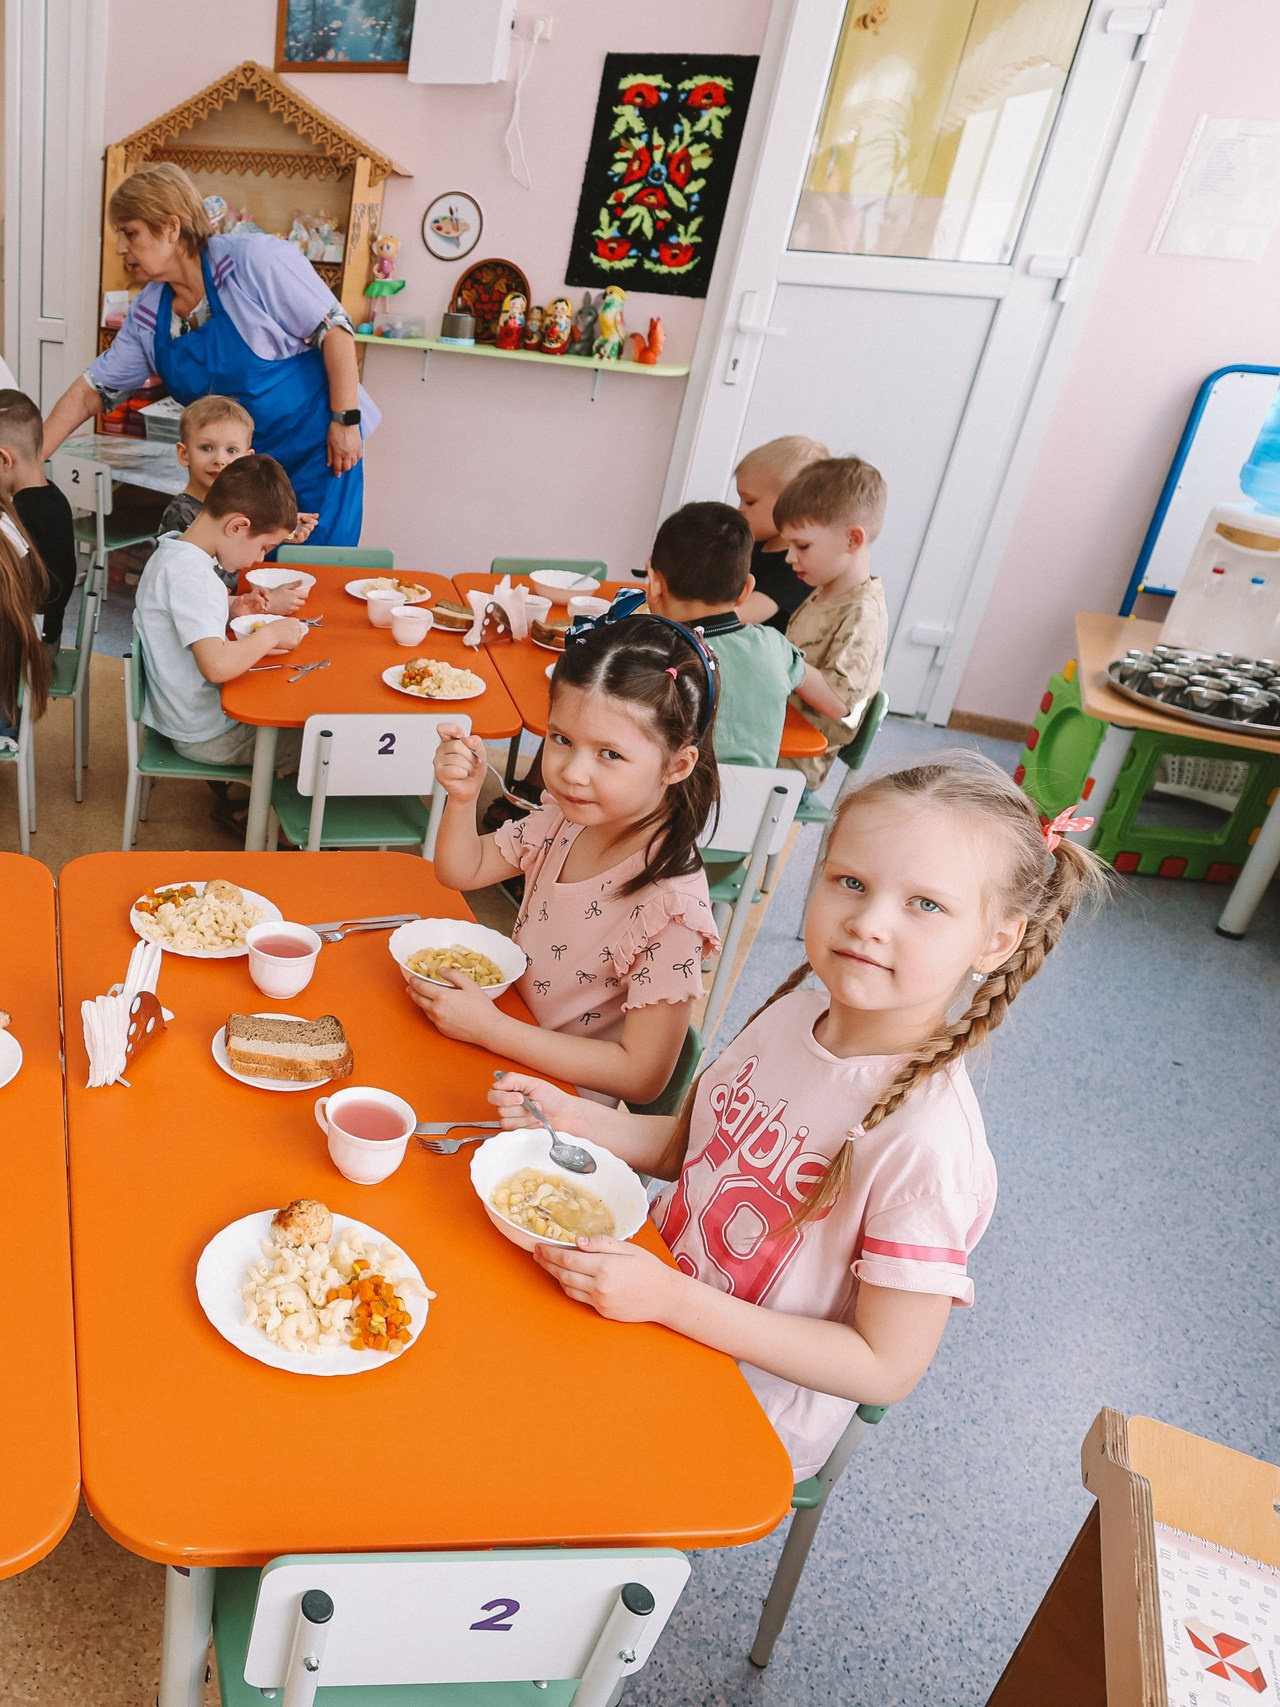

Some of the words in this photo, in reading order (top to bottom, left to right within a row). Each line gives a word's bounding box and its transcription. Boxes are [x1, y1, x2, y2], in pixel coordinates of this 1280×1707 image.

[71, 469, 80, 485] 2
[378, 733, 396, 755] 2
[468, 1598, 521, 1632] 2
